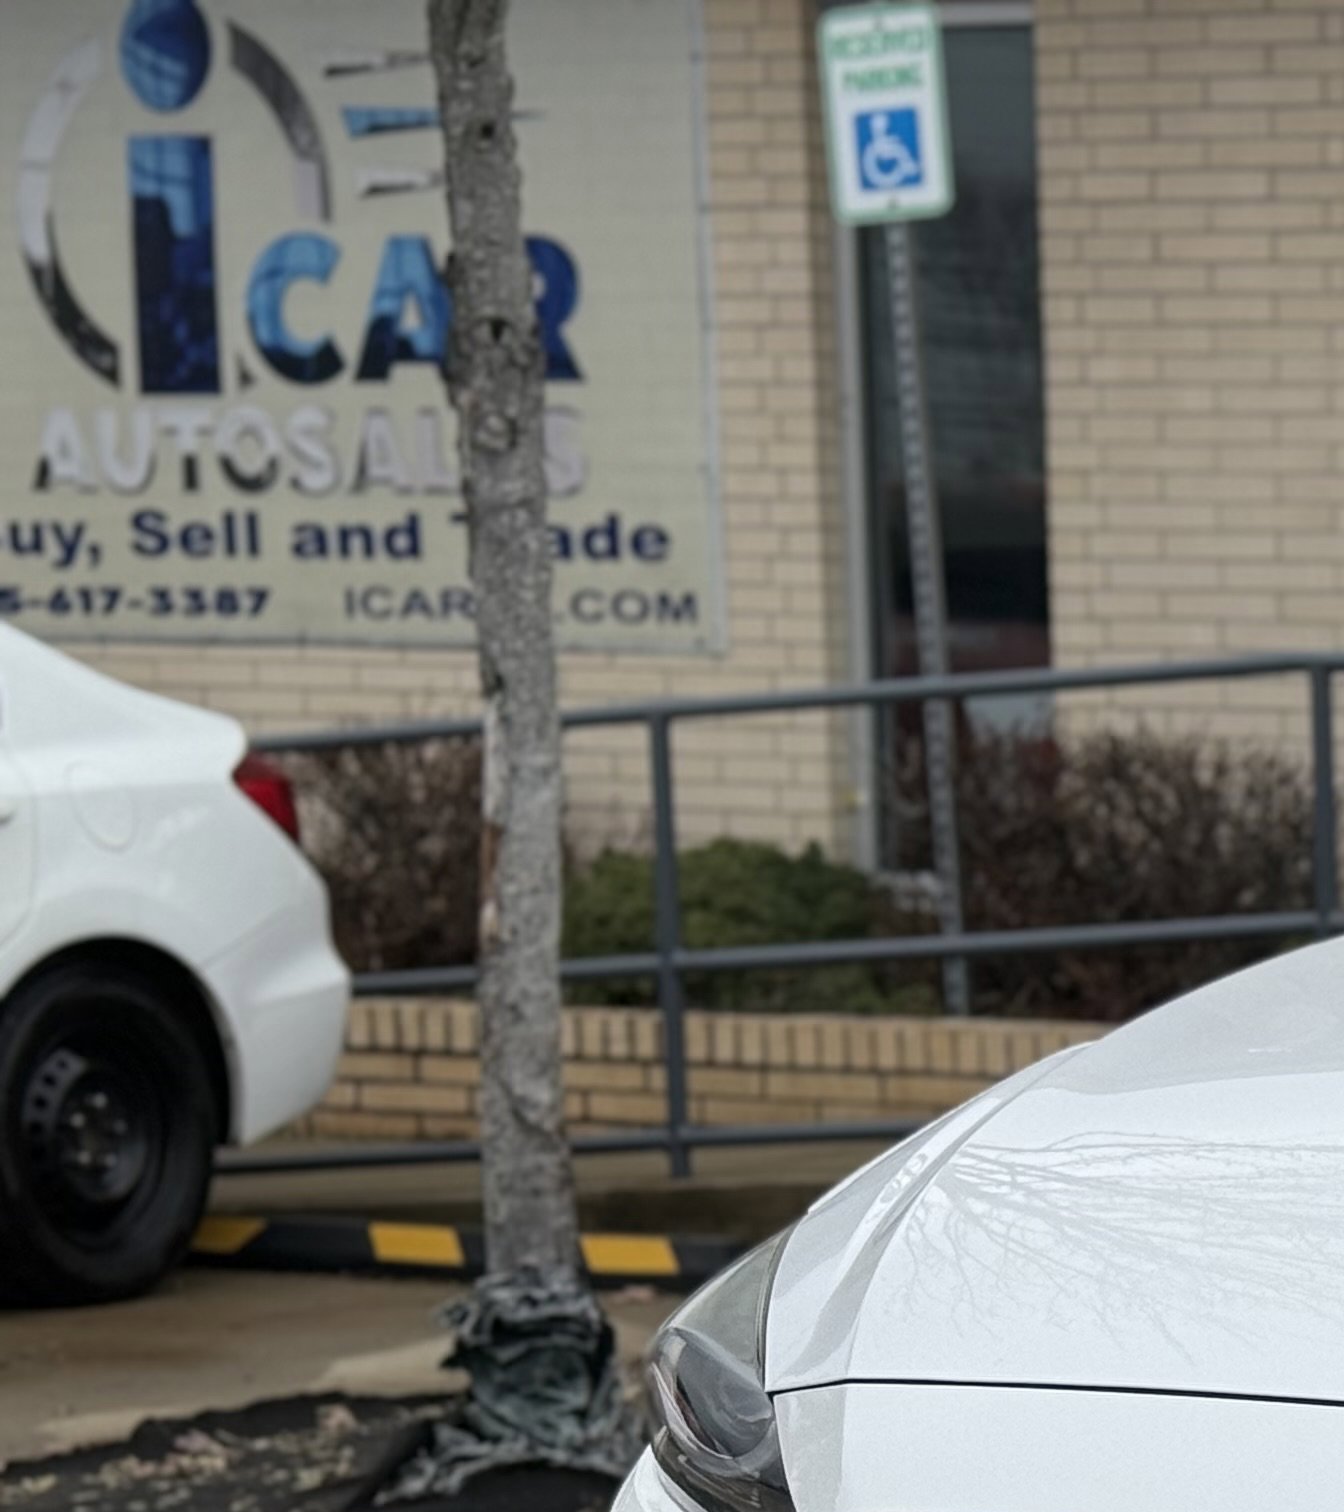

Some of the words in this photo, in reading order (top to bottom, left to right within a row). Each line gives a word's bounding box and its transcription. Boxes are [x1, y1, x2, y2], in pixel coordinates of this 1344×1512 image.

[33, 406, 591, 497] AUTOSALS
[0, 517, 102, 568] uy,
[129, 508, 261, 559] Sell
[291, 511, 421, 561] and
[449, 511, 670, 562] ade
[345, 584, 699, 625] ICAR.COM
